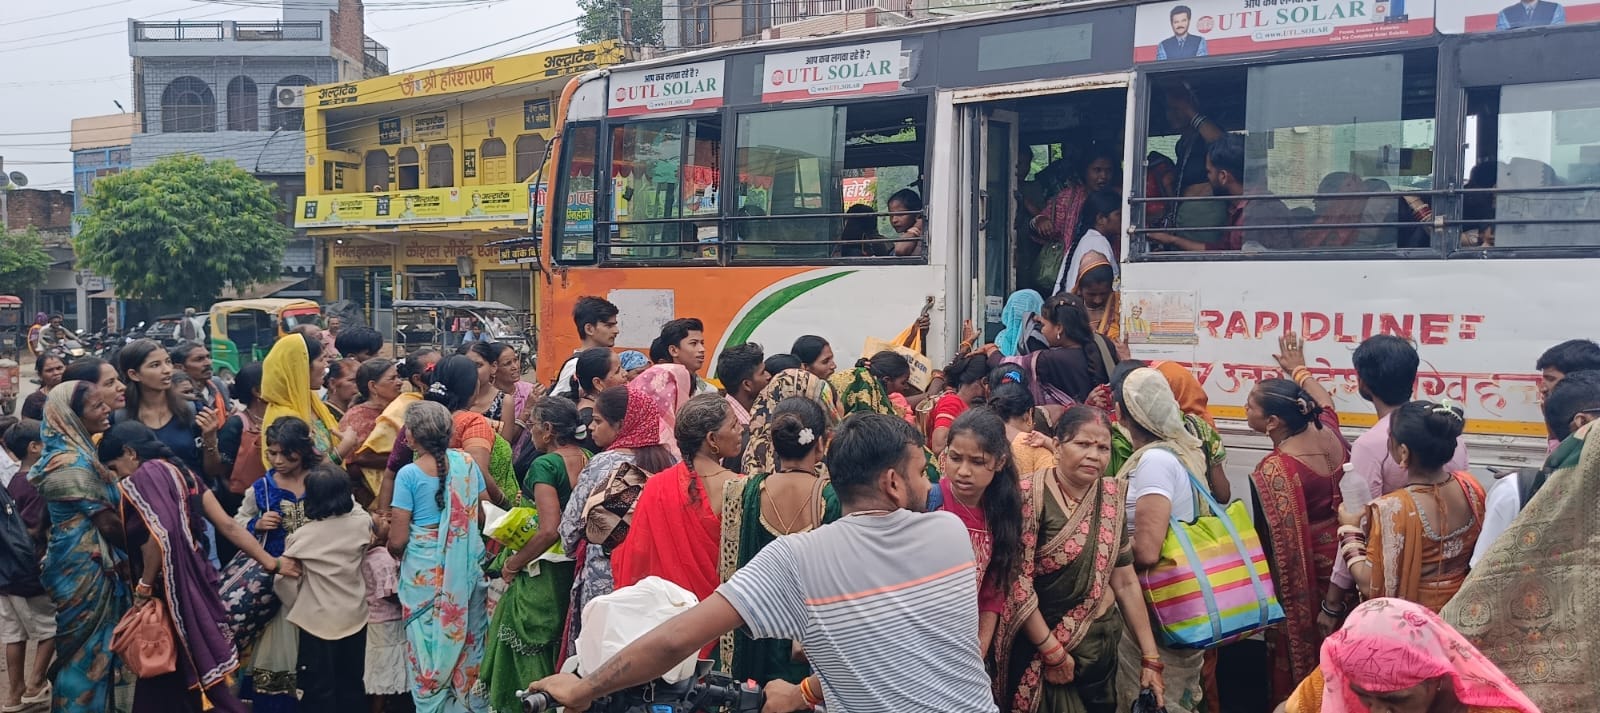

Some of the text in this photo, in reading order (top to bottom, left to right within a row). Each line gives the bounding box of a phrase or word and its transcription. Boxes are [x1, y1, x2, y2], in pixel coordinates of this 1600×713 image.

[1217, 0, 1366, 31] UTL SOLAR
[423, 69, 437, 93] श्री
[787, 60, 892, 84] UTL SOLAR
[629, 77, 717, 100] UTL SOLAR
[1200, 310, 1455, 345] RAPIDLINE
